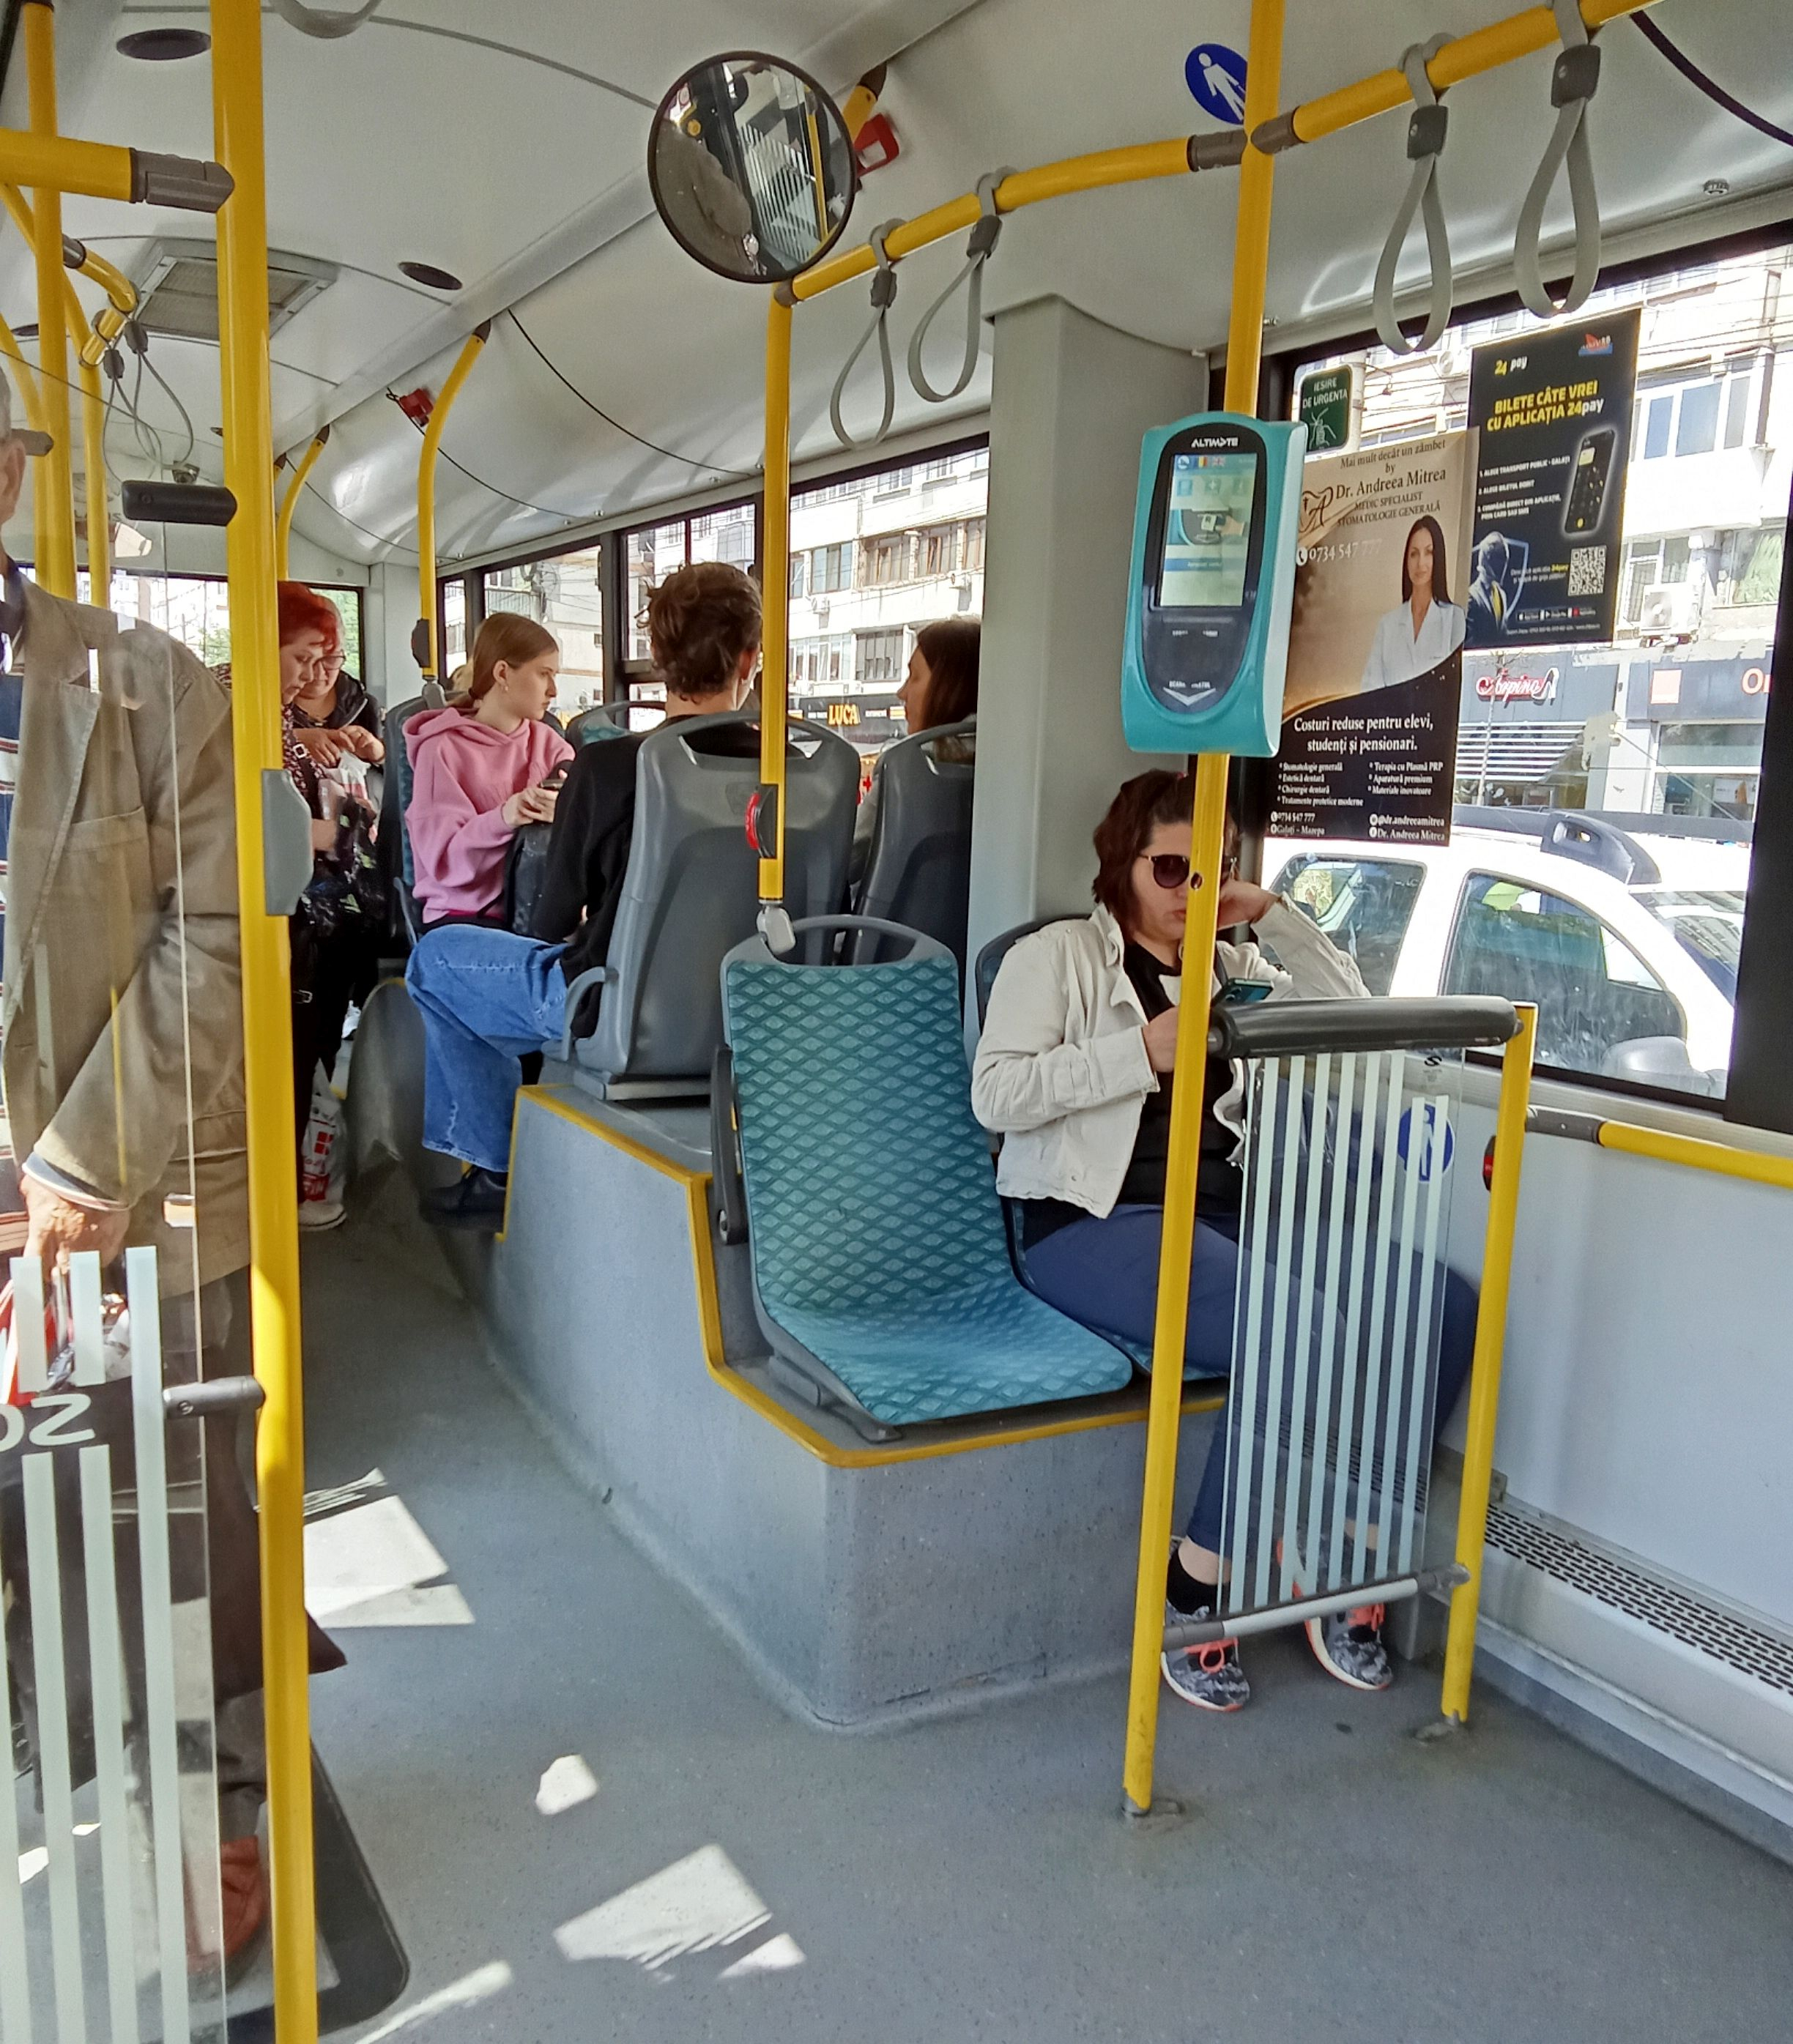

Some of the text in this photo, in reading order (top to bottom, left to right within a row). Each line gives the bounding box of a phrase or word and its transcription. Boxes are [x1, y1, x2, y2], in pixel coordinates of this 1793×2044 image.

[1510, 356, 1528, 371] pay
[1313, 377, 1337, 392] IESIRE
[1302, 388, 1348, 409] DE URGENTA
[1494, 379, 1598, 415] BILETE CÂTE VREI
[1487, 398, 1605, 431] CU APLICAȚIA 24pay
[1340, 439, 1446, 469] Mai mult decât un zâmbet
[1385, 463, 1395, 474] by
[1336, 469, 1447, 499] Dr. Andreea Mitrea
[1354, 491, 1424, 511] MEDIC SPECIALIST
[1337, 510, 1397, 527] STOMATOLOGIE
[1309, 545, 1336, 562] 0734
[1338, 541, 1358, 560] 547
[828, 704, 861, 725] LUCA
[1294, 713, 1434, 734] Costuri reduse pentru elevi,
[1307, 735, 1418, 755] studenți și pensionari.
[1374, 761, 1397, 773] Terapia
[1397, 764, 1405, 772] cu
[1429, 762, 1444, 772] PRP
[1403, 774, 1433, 785] premium
[1337, 797, 1364, 807] moderne
[1304, 812, 1315, 822] 777
[1377, 828, 1445, 841] Dr. Andreea Mitrea
